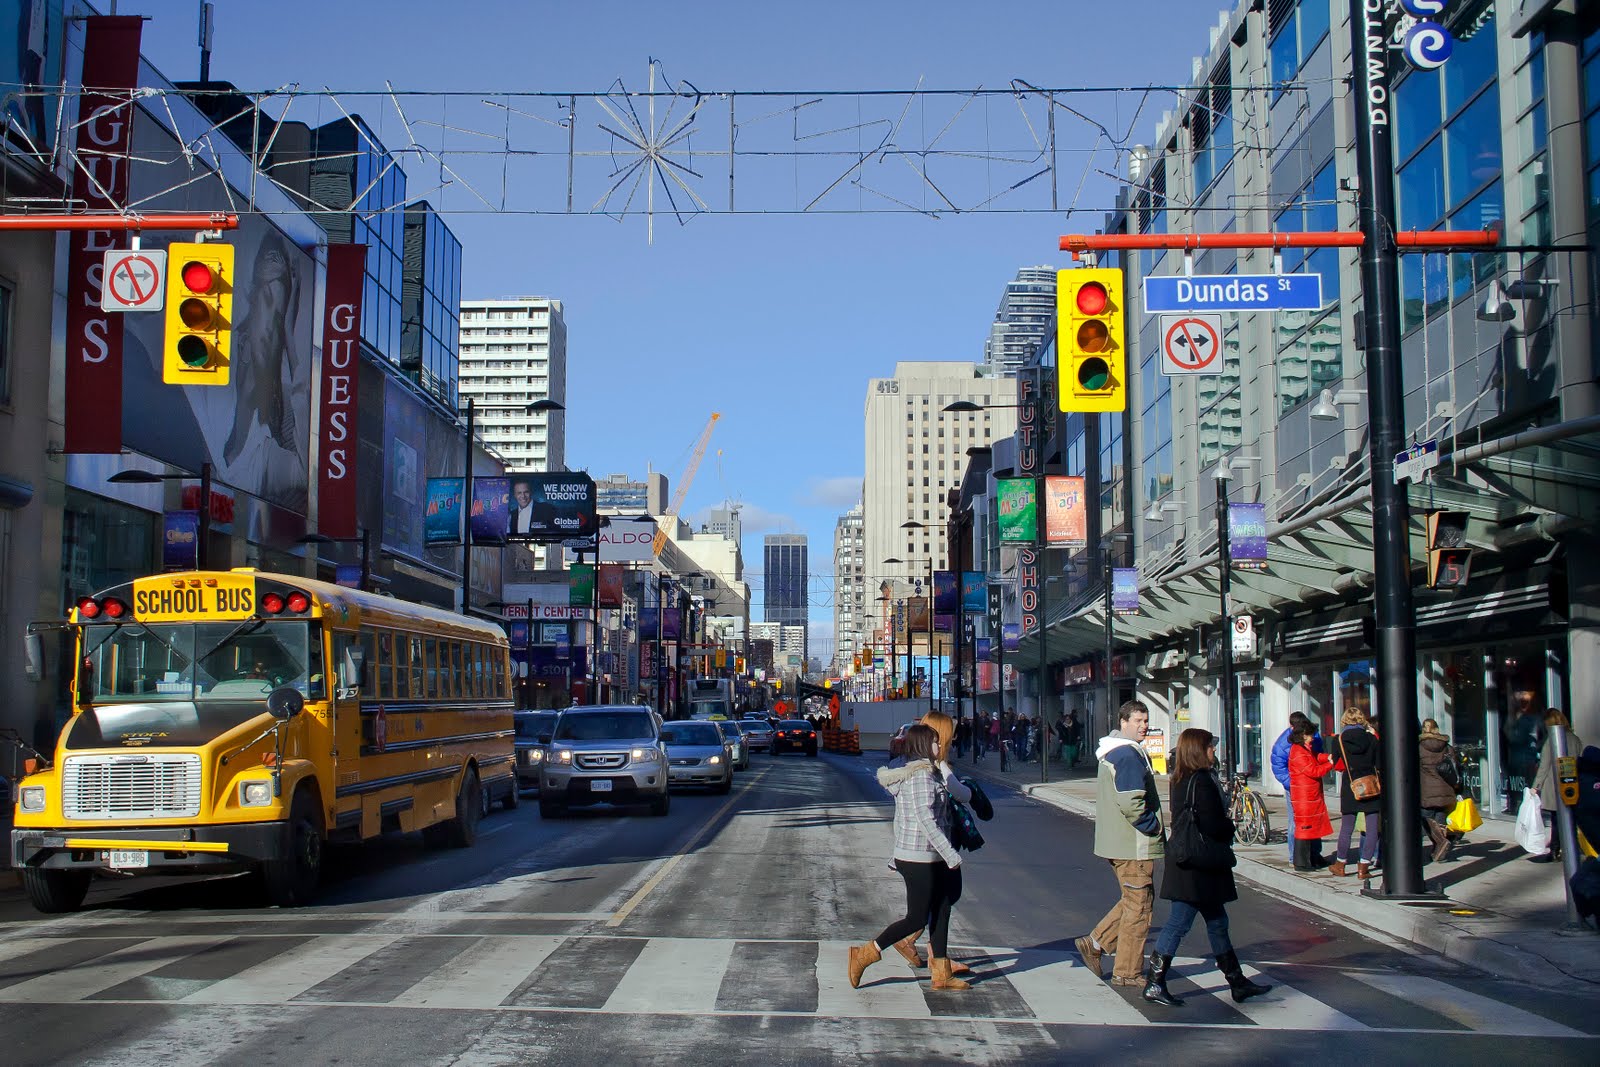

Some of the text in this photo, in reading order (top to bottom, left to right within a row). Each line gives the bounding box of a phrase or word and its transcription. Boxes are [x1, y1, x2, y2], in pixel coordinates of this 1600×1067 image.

[81, 104, 126, 363] GUESS
[1176, 278, 1291, 303] Dundas St
[328, 304, 356, 479] GUESS
[877, 380, 899, 394] 415
[1020, 380, 1035, 478] FUTU
[543, 484, 588, 492] WE KNOW
[545, 492, 588, 500] TORONTO
[427, 493, 461, 516] Magic
[471, 494, 509, 516] Magic
[1001, 491, 1034, 516] Magic
[554, 517, 580, 526] Global
[1233, 521, 1265, 538] wish
[599, 532, 652, 544] ALDO
[1447, 555, 1459, 582] 5
[137, 587, 252, 614] SCHOOL BUS
[1021, 548, 1037, 635] SHOP
[503, 606, 583, 617] TERNT CENTRE
[990, 594, 999, 629] HMV
[965, 614, 973, 643] HMV
[313, 709, 333, 718] 755
